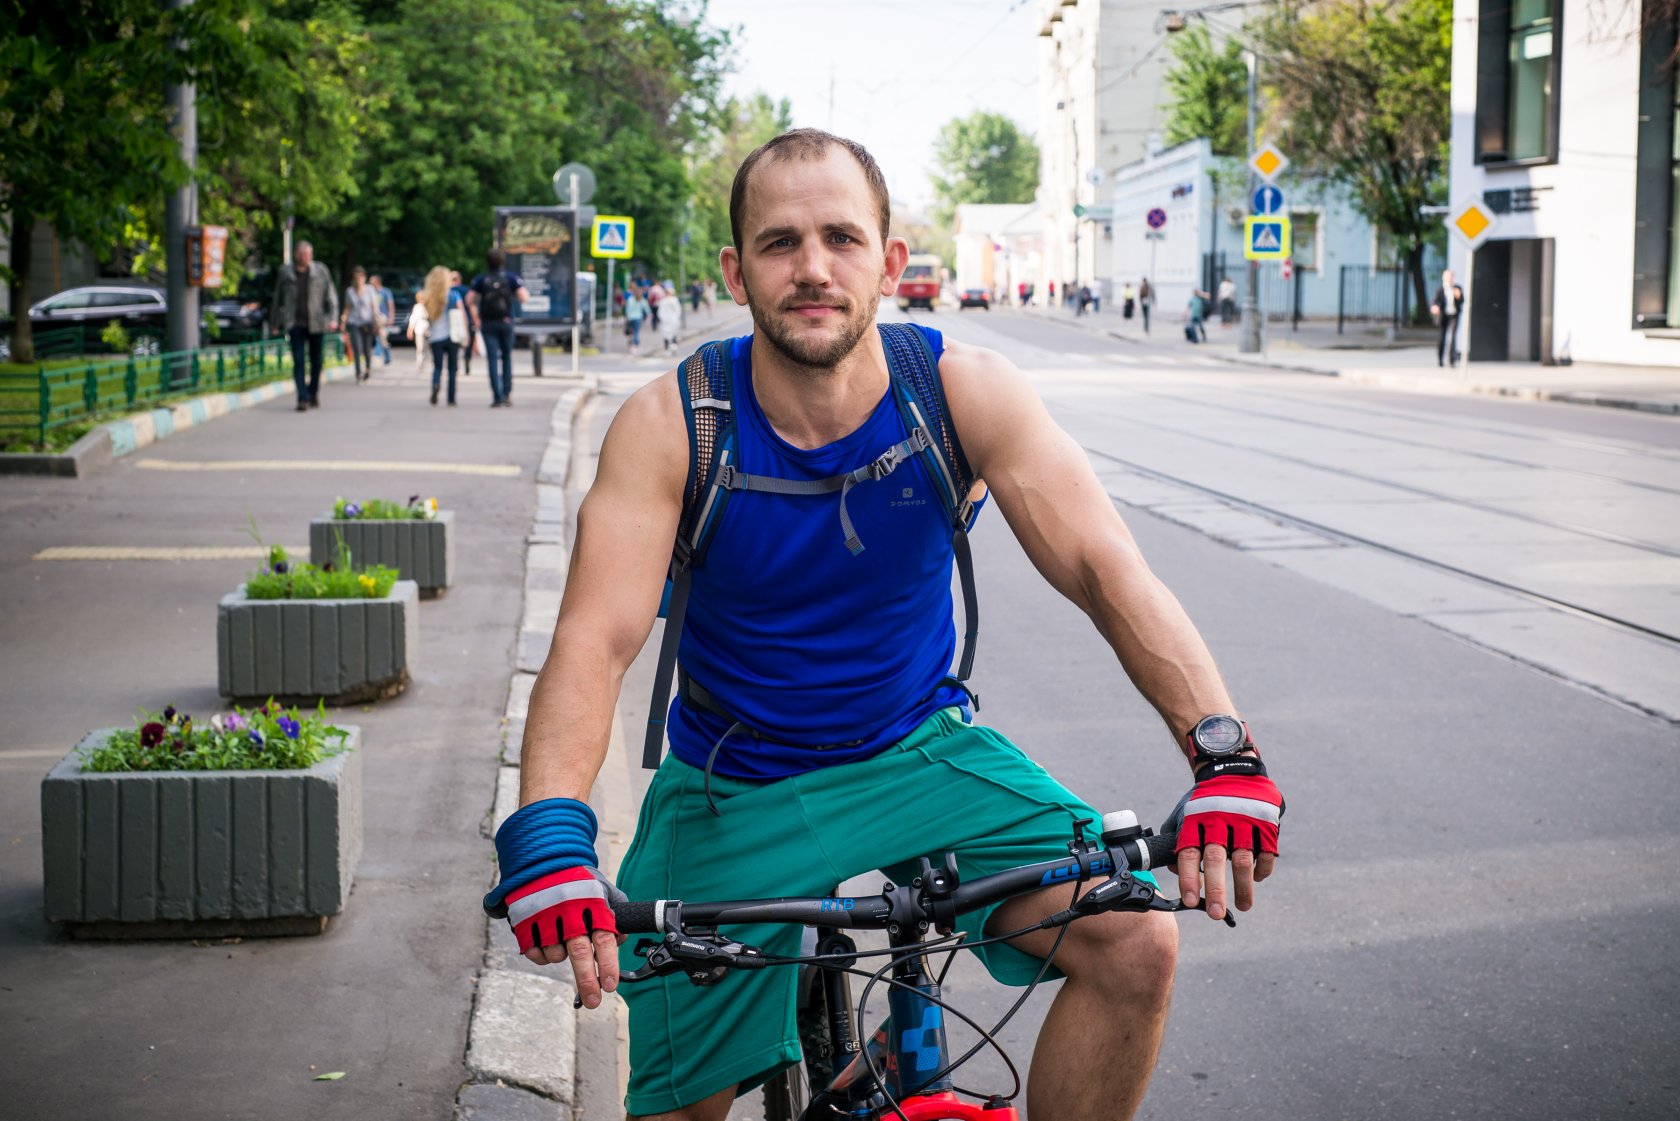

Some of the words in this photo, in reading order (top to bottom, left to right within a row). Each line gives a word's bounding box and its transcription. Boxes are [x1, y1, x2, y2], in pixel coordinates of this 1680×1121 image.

[1096, 881, 1118, 894] SHIMANO
[821, 898, 855, 912] RTB
[681, 941, 706, 951] SHIMANO
